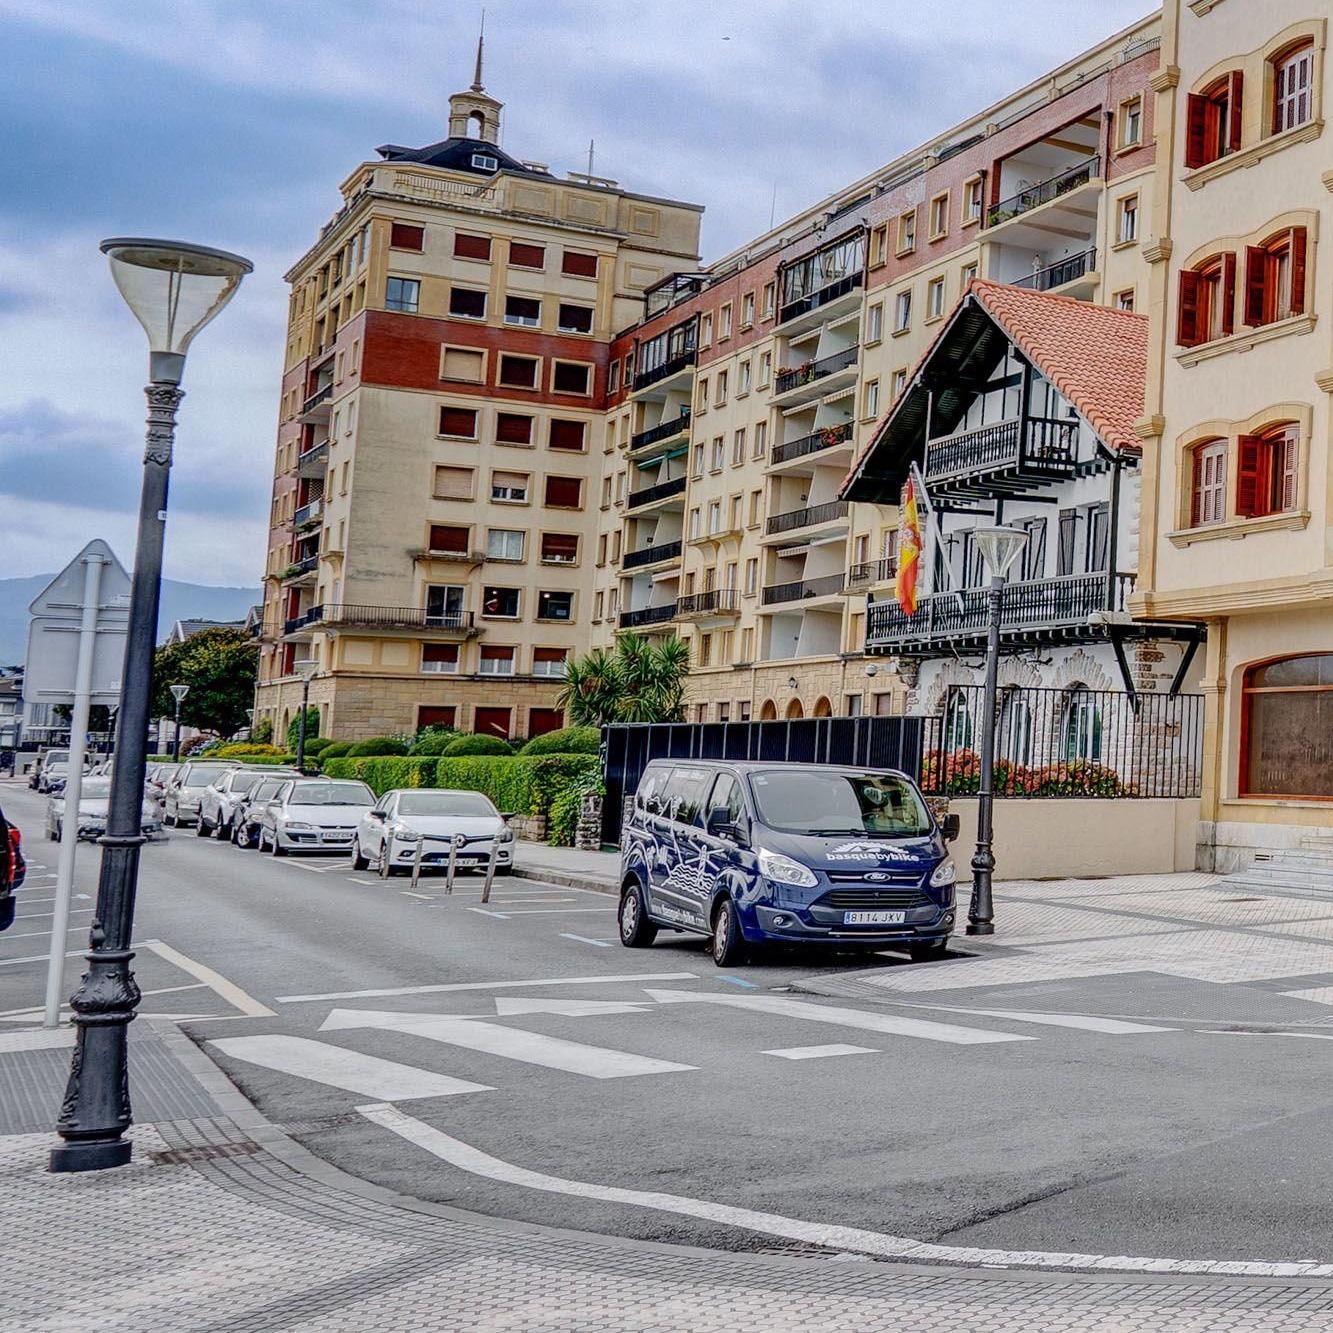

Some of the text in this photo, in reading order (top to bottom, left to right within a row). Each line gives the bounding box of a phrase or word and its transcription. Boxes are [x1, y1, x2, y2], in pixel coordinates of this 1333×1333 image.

[826, 853, 919, 862] basquebybike
[850, 912, 901, 922] 8114 JXV
